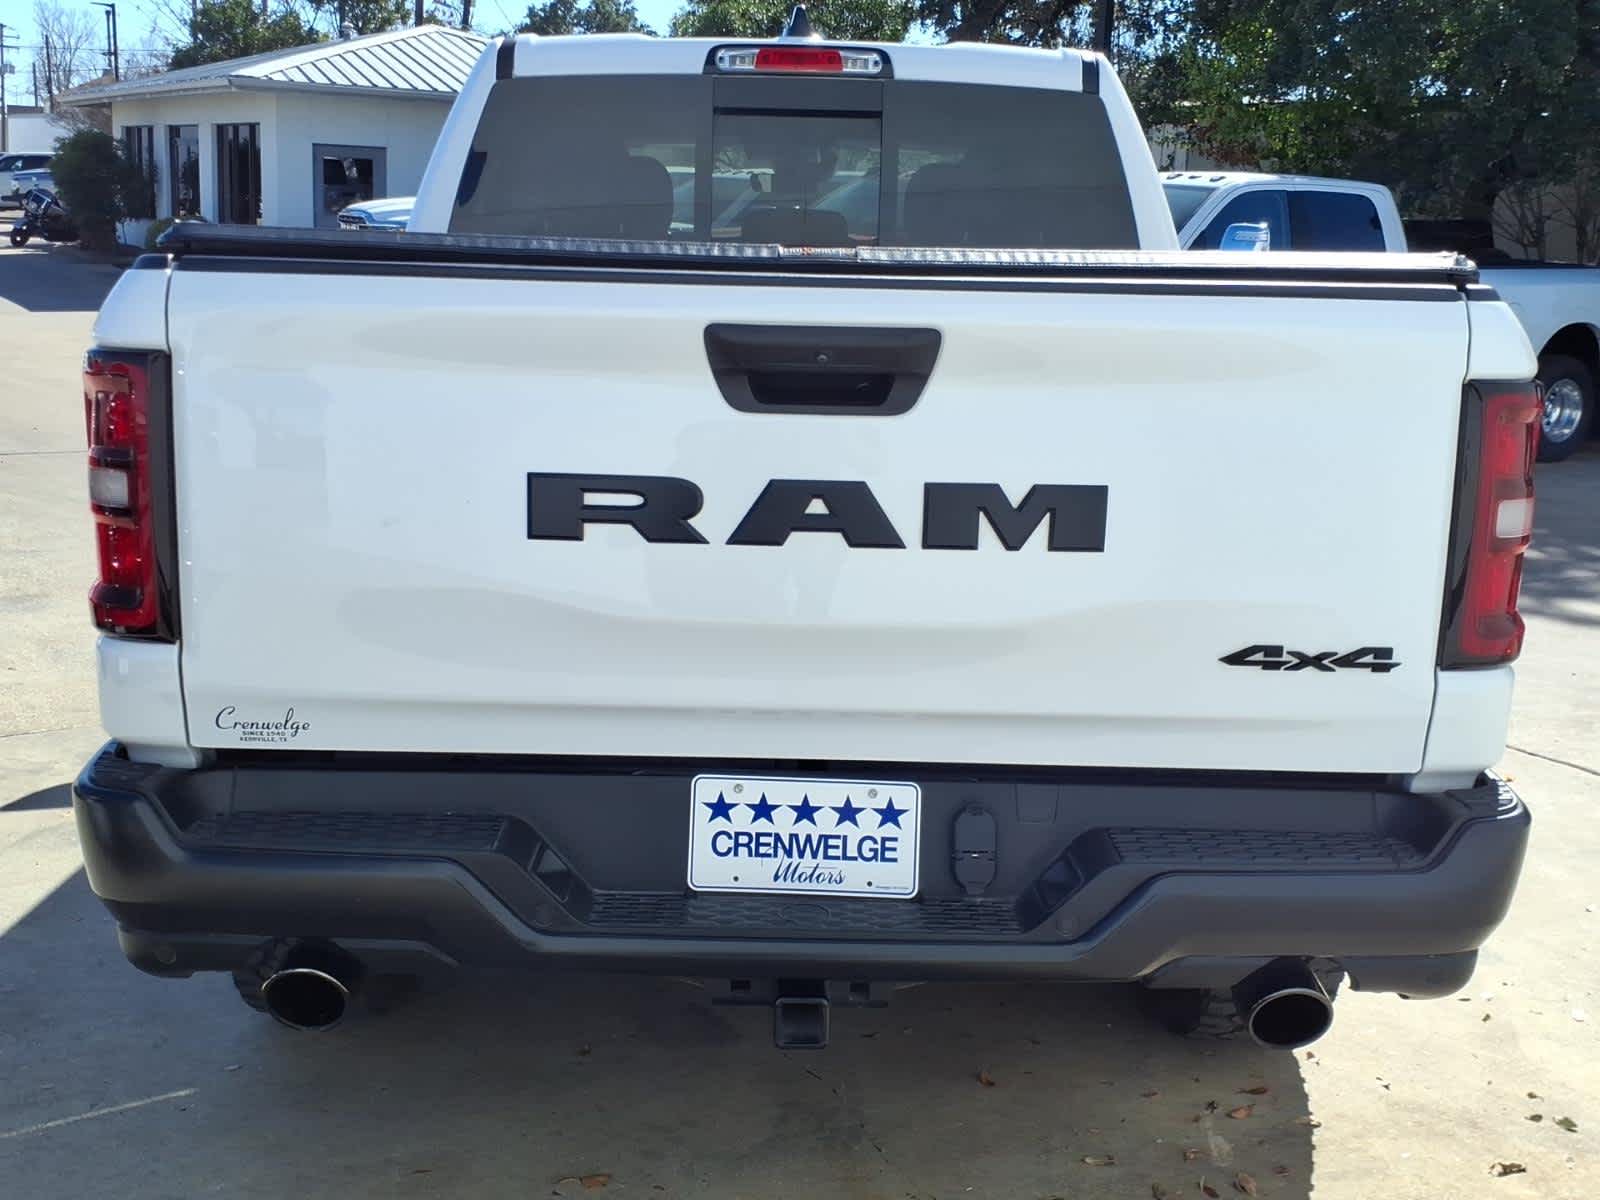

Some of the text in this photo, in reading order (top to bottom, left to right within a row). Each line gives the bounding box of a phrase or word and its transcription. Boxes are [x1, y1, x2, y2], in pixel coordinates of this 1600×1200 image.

[526, 471, 1109, 553] RAM
[1217, 644, 1402, 673] 4x4
[215, 705, 311, 738] Crenwelge
[711, 830, 899, 863] CRENWELGE
[768, 851, 846, 885] Motors
